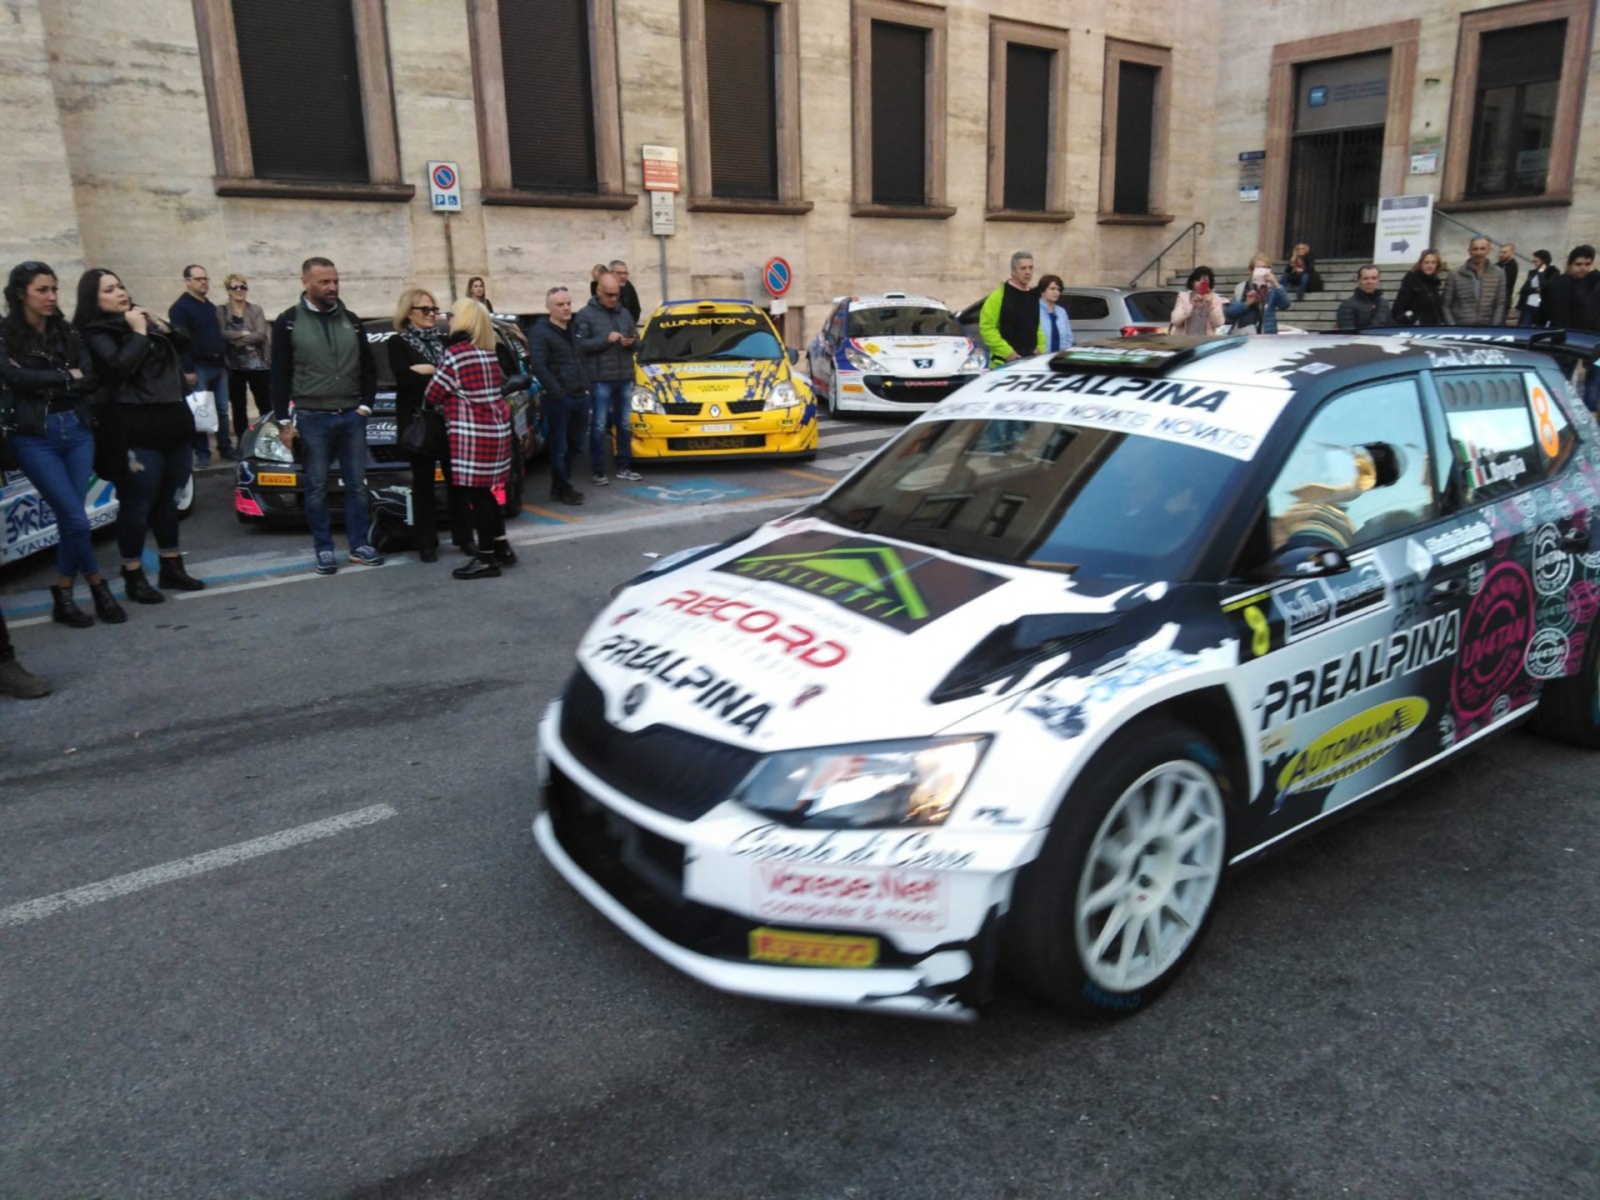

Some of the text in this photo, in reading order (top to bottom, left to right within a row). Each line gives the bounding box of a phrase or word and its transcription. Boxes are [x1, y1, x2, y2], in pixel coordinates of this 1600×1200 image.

[984, 374, 1231, 413] PREALPINA
[1155, 416, 1256, 450] NOVATIS
[1532, 386, 1560, 458] 8
[658, 590, 850, 669] RECORD
[598, 634, 776, 736] PREALPINA
[1256, 609, 1461, 732] PREALPINA
[1280, 705, 1407, 798] AUTOMANIA
